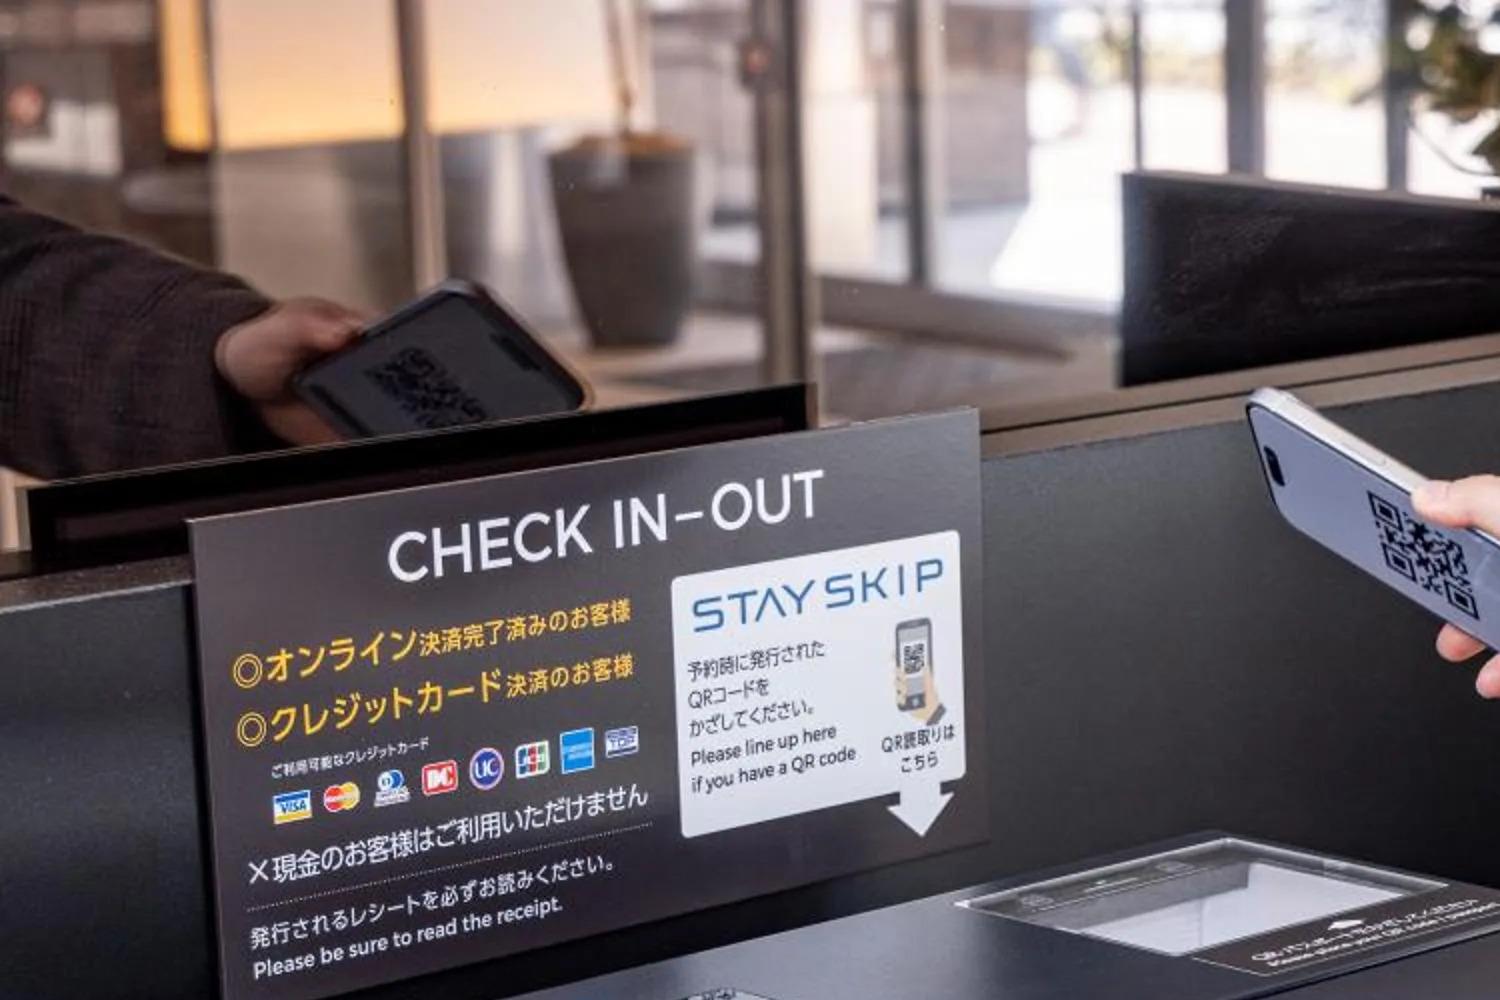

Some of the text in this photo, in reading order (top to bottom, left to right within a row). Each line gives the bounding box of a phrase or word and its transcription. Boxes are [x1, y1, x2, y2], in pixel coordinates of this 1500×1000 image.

[388, 504, 593, 583] CHECK
[687, 640, 826, 683] 予約時に発行された
[687, 678, 770, 710] QRコードを
[691, 726, 837, 768] Please line up here
[881, 725, 955, 754] QR読取りは
[691, 747, 857, 795] if you have a QR code
[901, 752, 939, 774] こちら
[280, 800, 308, 814] VISA
[474, 757, 499, 780] UC
[253, 897, 564, 981] Please be sure to read the receipt.
